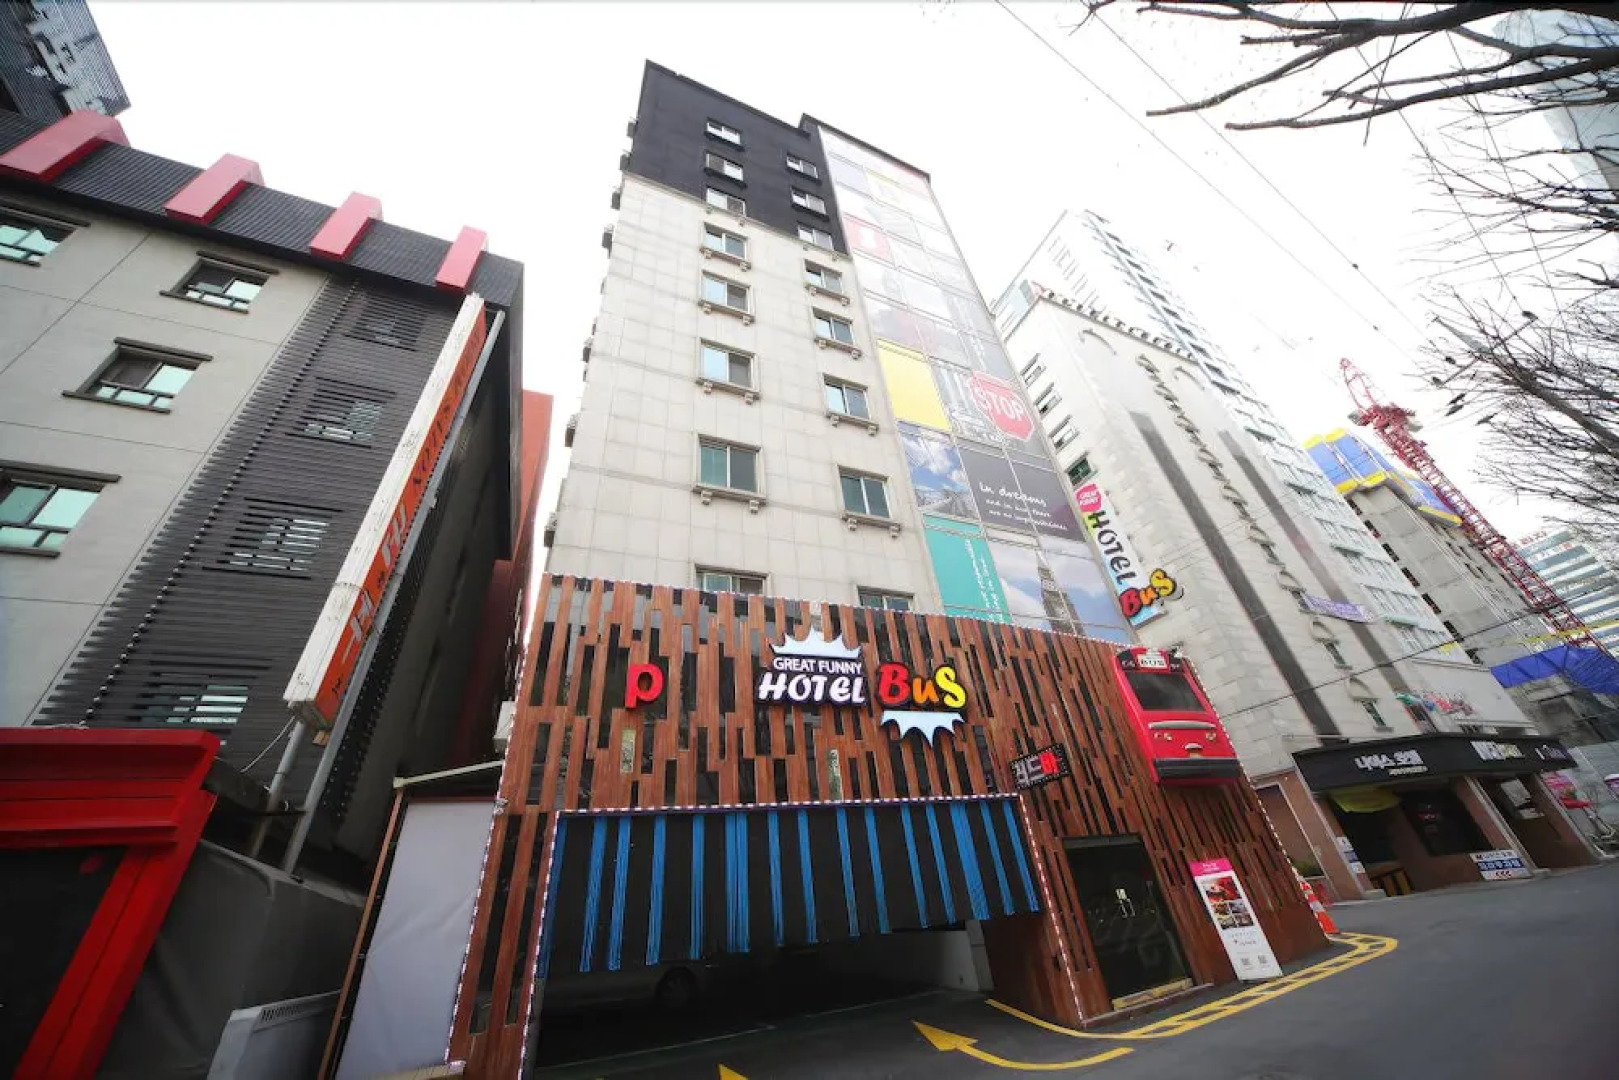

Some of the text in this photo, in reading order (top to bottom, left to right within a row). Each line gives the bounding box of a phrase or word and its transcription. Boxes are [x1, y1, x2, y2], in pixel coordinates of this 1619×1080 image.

[974, 388, 1024, 421] STOP
[773, 657, 862, 674] GREAT FUNNY
